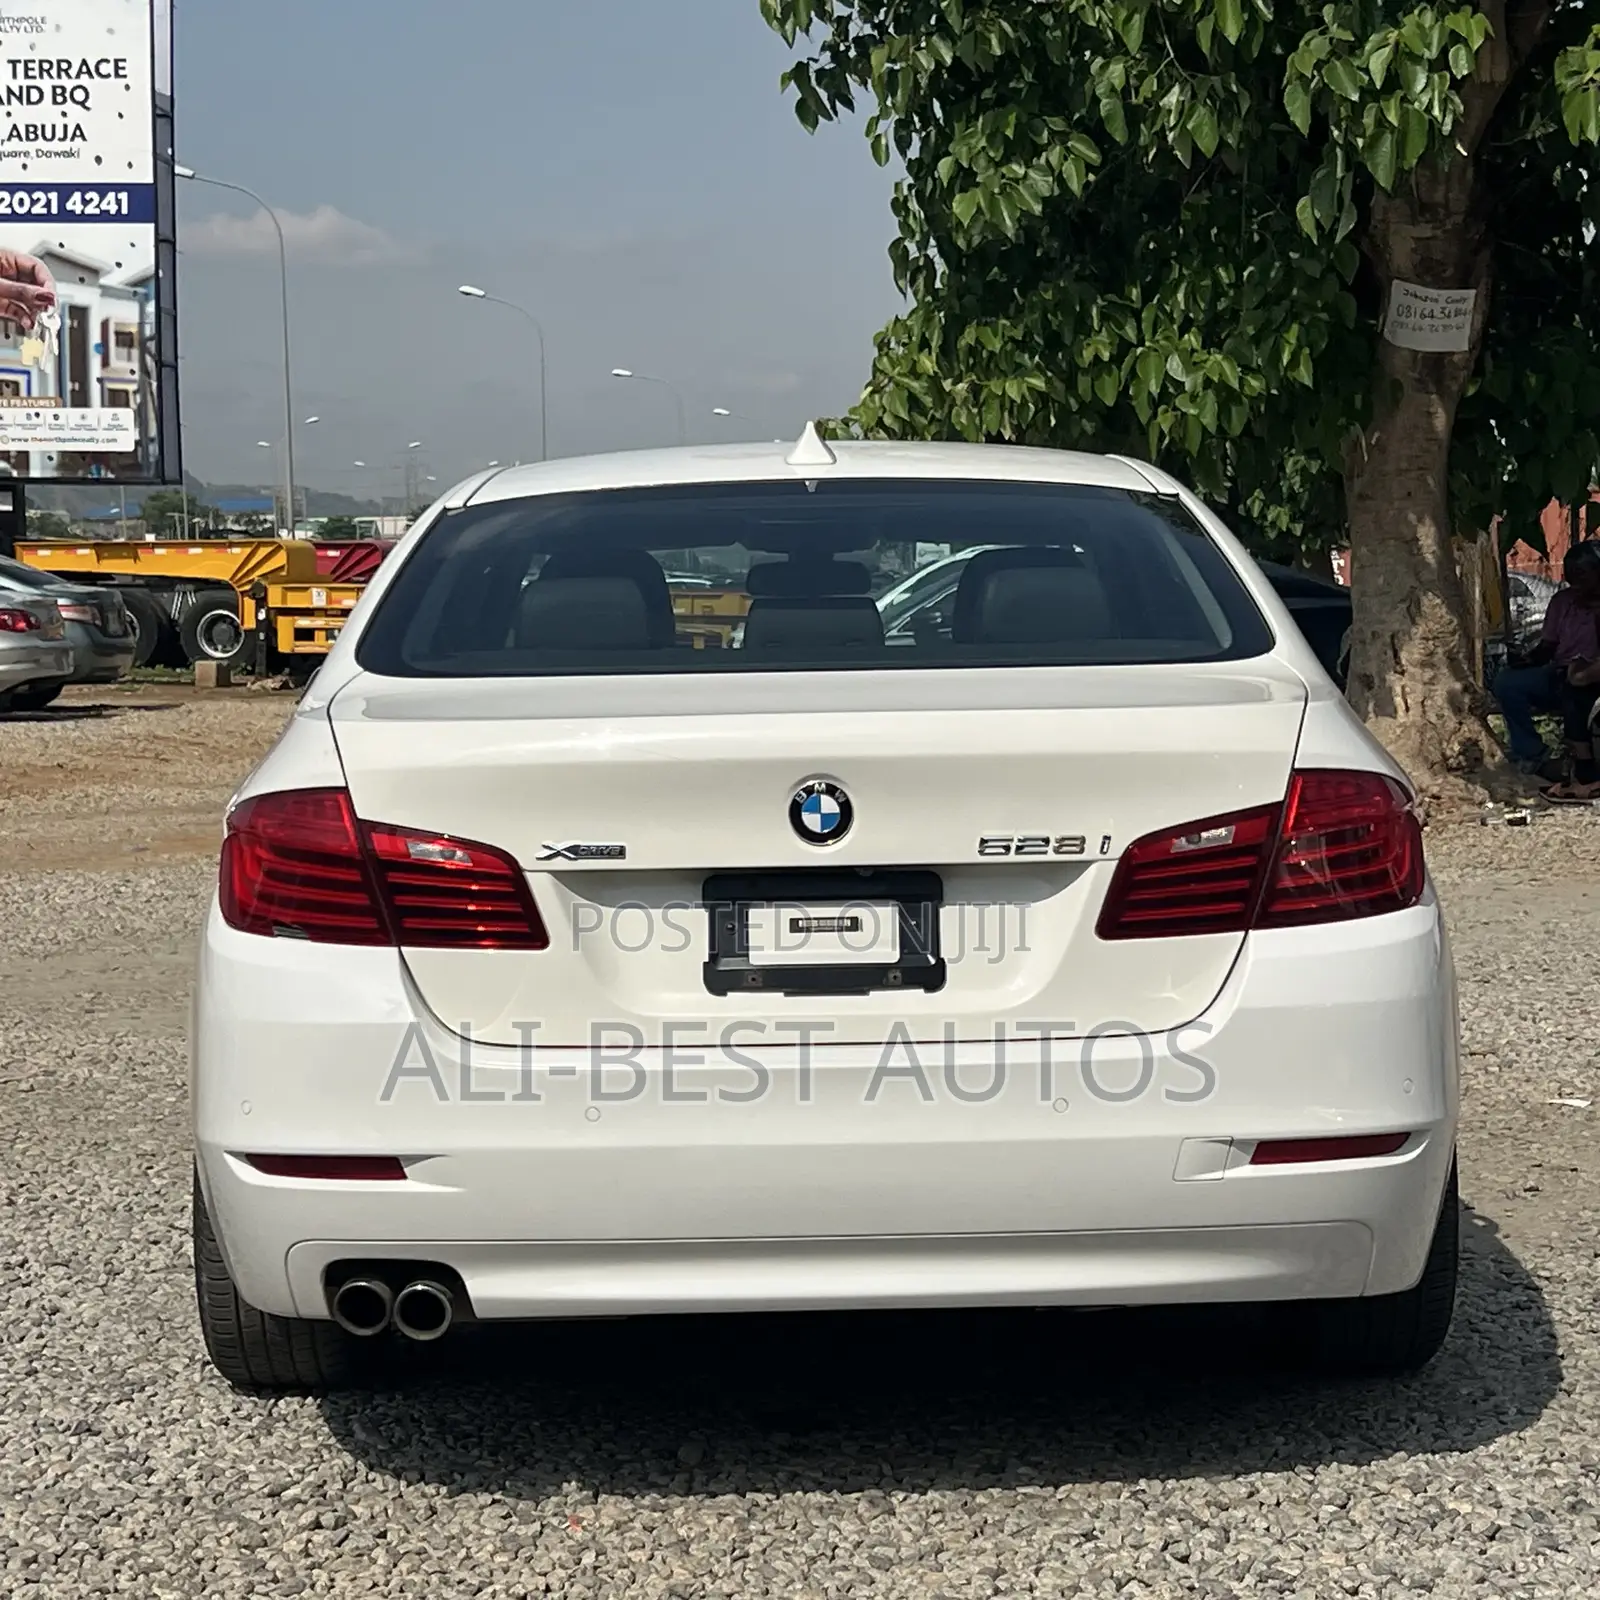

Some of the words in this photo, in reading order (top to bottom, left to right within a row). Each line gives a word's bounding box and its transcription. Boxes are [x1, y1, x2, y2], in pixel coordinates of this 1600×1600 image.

[7, 58, 128, 80] TERRACE
[0, 85, 45, 106] ND
[51, 85, 92, 112] BQ
[35, 146, 81, 159] Dawaki
[0, 190, 58, 214] 2021
[65, 191, 129, 215] 4241
[11, 399, 56, 408] FEATURES
